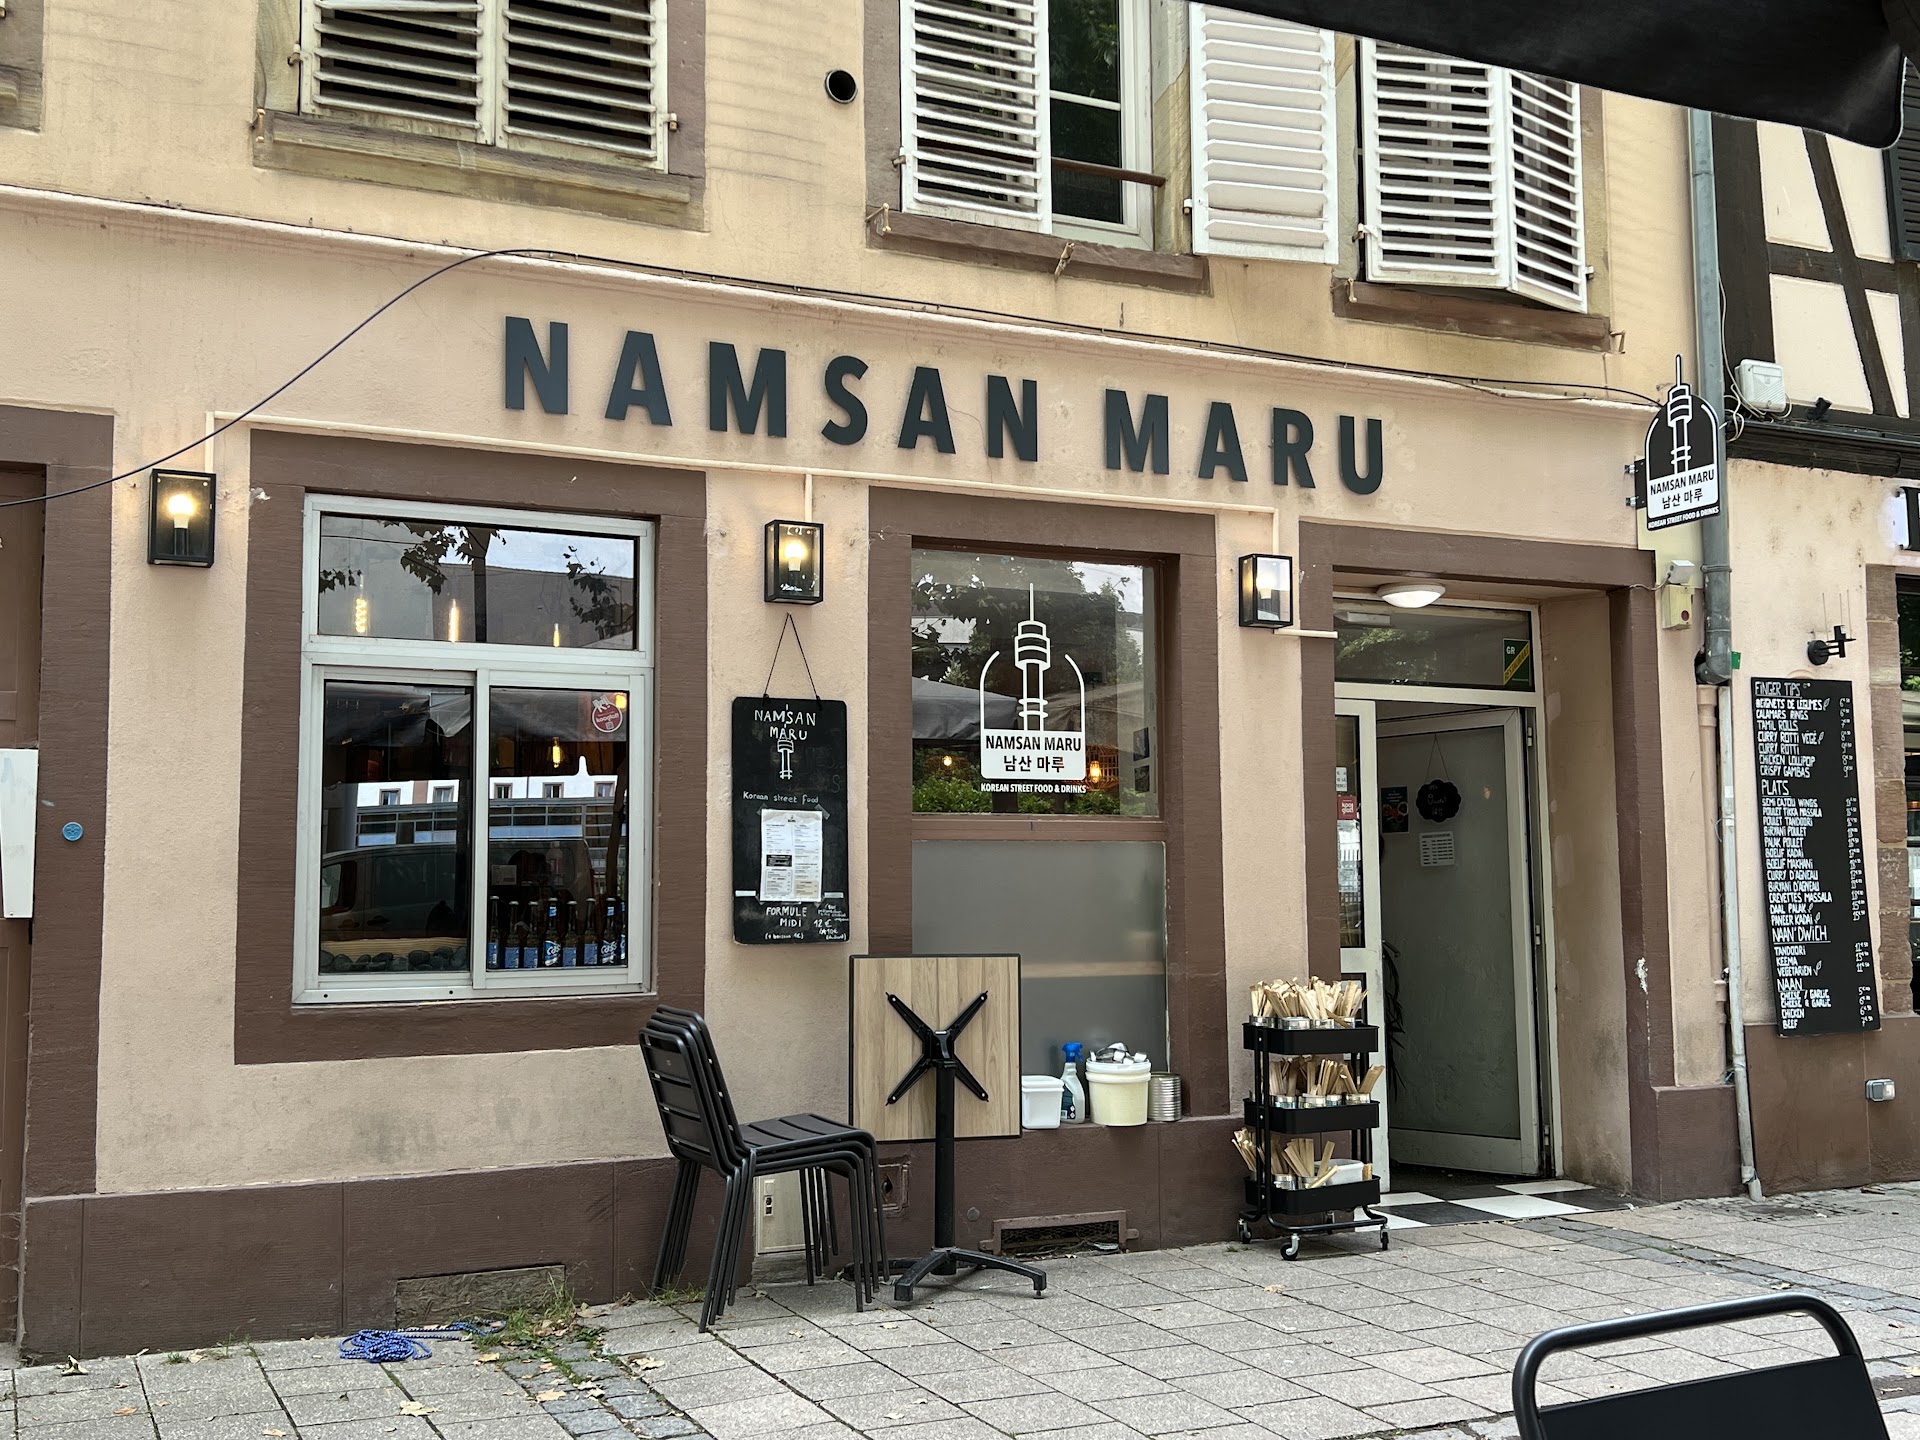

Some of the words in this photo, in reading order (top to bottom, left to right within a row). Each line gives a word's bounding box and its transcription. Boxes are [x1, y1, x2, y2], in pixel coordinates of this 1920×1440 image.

[505, 315, 1038, 463] NAMSAN
[1106, 388, 1383, 495] MARU
[1650, 476, 1686, 496] NAMSAN
[1689, 469, 1715, 486] MARU
[1662, 493, 1681, 510] 남산
[1684, 488, 1703, 503] 마루
[1648, 519, 1667, 529] KOREAN
[1667, 514, 1683, 525] STREET
[1683, 512, 1696, 521] FOOD
[1701, 506, 1719, 517] DRINKS
[1787, 699, 1795, 709] DE
[755, 710, 816, 726] NAMSAN
[1756, 709, 1786, 719] CALAMARS
[1778, 720, 1799, 731] ROLLS
[770, 727, 807, 740] MARU
[1757, 731, 1778, 742] CURRY
[986, 735, 1040, 750] NAMSAN
[1044, 737, 1081, 751] MARU
[1758, 743, 1778, 754] CURRY
[1004, 755, 1031, 772] 남산
[1037, 756, 1064, 773] 마루
[1783, 766, 1810, 778] GAMBAS
[981, 783, 1009, 792] KOREAN
[1010, 783, 1034, 793] STREET
[1034, 784, 1053, 793] FOOD
[1054, 785, 1060, 793] &
[1061, 785, 1087, 793] DRINKS
[1761, 779, 1790, 795] PLATS
[743, 791, 768, 800] Korean
[773, 794, 797, 803] street
[802, 794, 818, 805] food
[1787, 827, 1807, 836] POULET
[1783, 838, 1804, 848] POULET
[1767, 870, 1786, 880] CURRY
[1769, 893, 1802, 903] CREVETTES
[1804, 892, 1832, 902] MASSALA
[766, 906, 807, 917] FORMULE
[1770, 904, 1786, 914] DAAL
[1788, 903, 1807, 914] PALAK
[814, 919, 822, 927] 12
[1771, 915, 1794, 926] PANEER
[1776, 956, 1798, 966] KEEMA
[1777, 978, 1802, 991] NAAN
[1780, 990, 1801, 1000] CHEESE
[1781, 1000, 1802, 1008] CHEESE
[1782, 1019, 1798, 1029] BEEF
